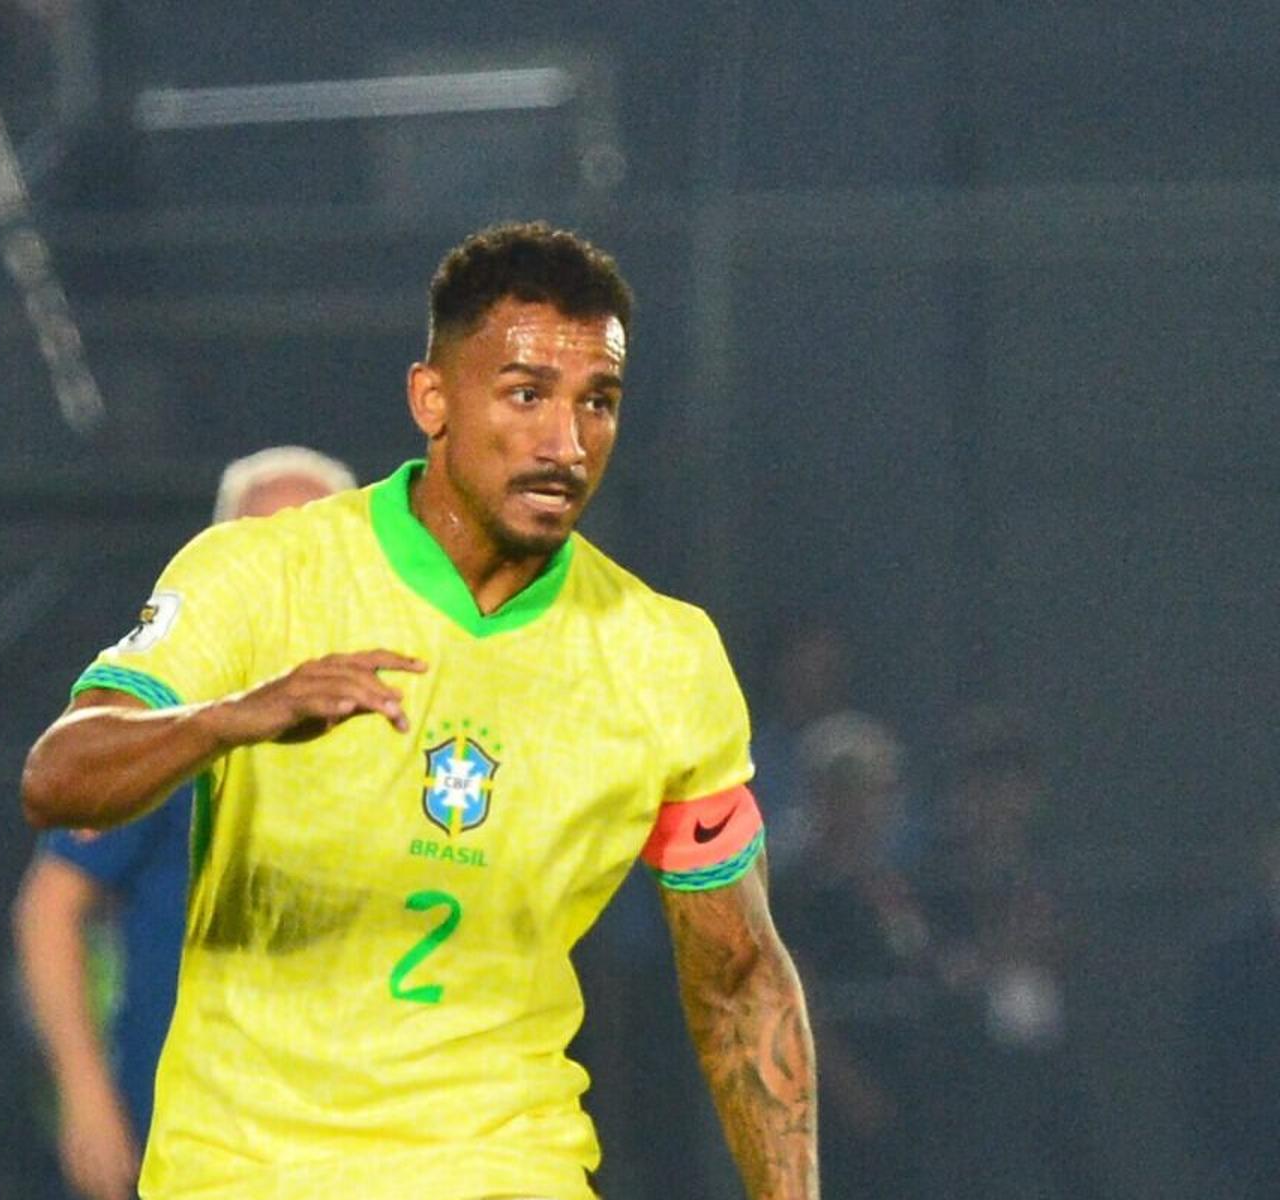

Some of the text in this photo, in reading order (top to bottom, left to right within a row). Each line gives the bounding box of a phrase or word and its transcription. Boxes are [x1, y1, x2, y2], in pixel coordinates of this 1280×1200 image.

[444, 776, 472, 789] CBF
[409, 839, 488, 867] BRASIL
[390, 889, 462, 1004] 2
